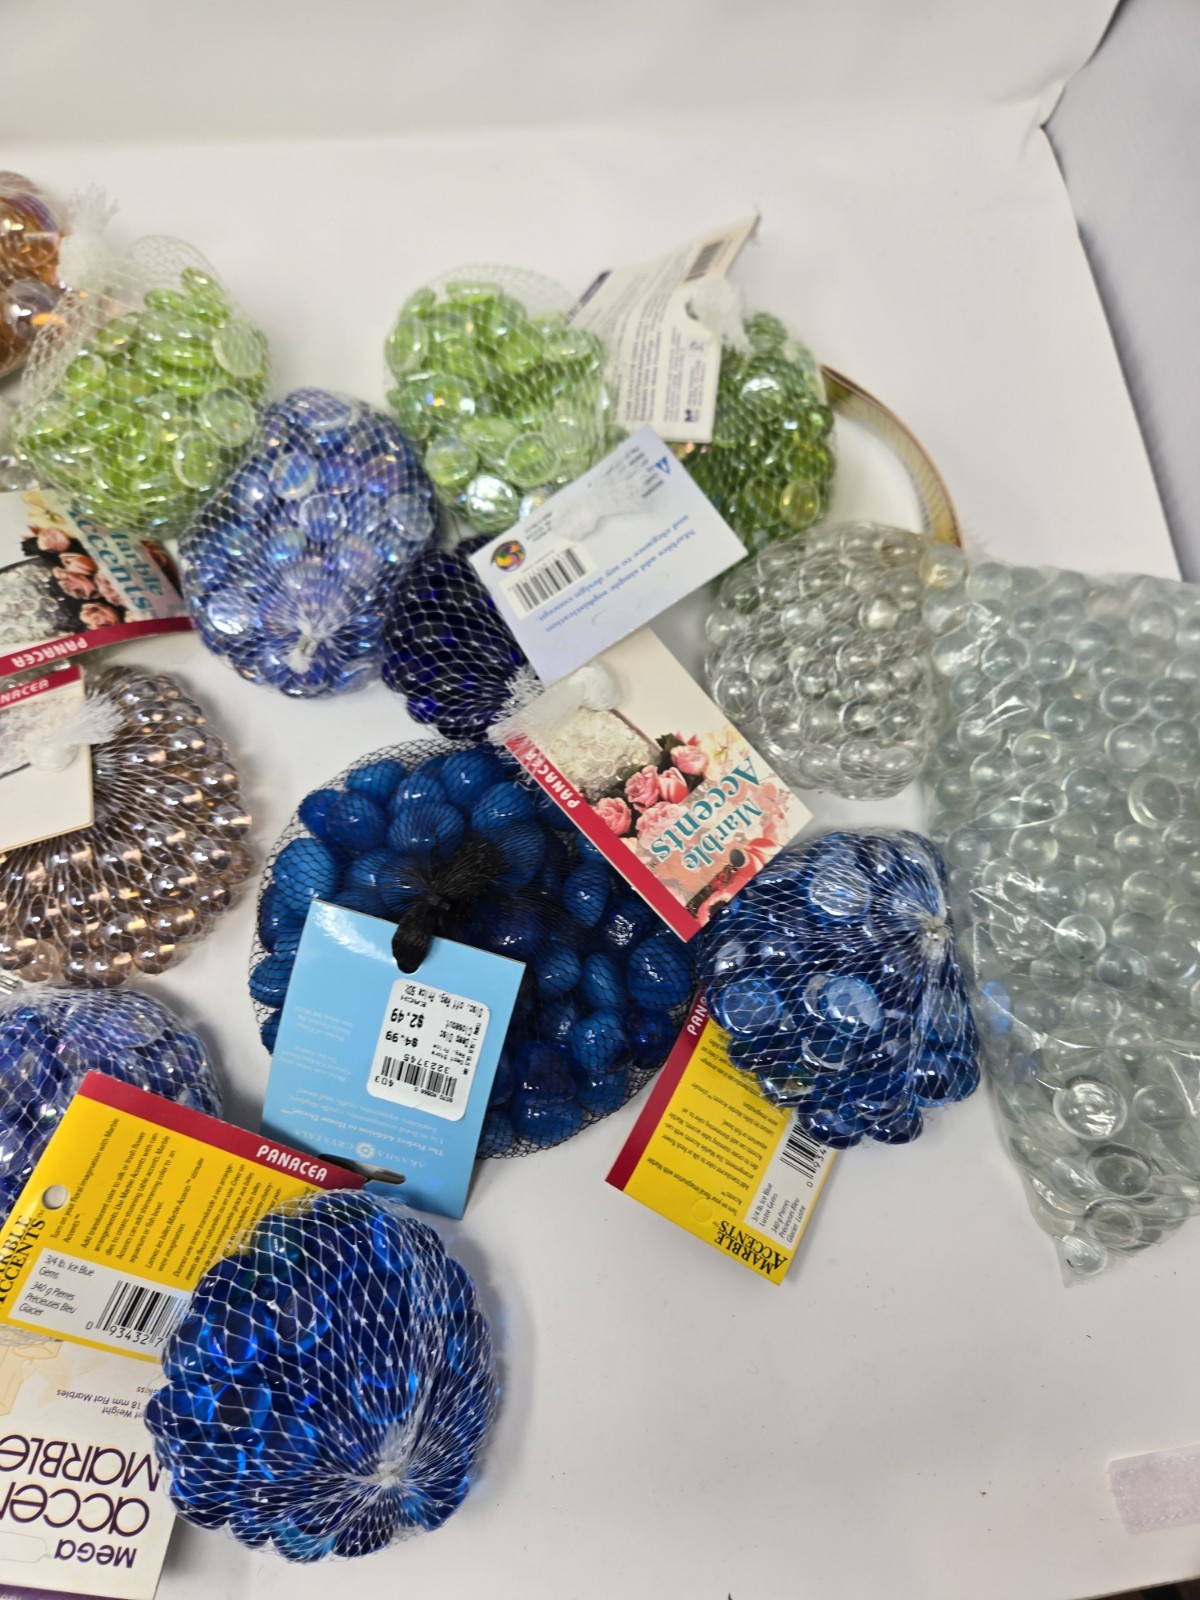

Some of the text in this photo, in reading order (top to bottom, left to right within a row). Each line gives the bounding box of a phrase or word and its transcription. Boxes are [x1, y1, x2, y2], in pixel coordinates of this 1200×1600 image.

[672, 515, 688, 530] and
[634, 528, 671, 558] elegance
[606, 565, 620, 577] any
[621, 557, 632, 566] to
[546, 530, 695, 632] Marbles add simple sophistication
[574, 577, 604, 598] design
[12, 638, 86, 666] PANACEA
[524, 749, 579, 808] PANACEA
[686, 803, 763, 868] Marble
[400, 995, 427, 1008] EACH
[390, 1008, 424, 1028] $2.49
[385, 1031, 418, 1048] $4.99
[403, 1054, 449, 1074] 3223745
[374, 1075, 394, 1087] 403
[257, 1146, 327, 1181] PANACEA
[50, 1119, 119, 1239] Turn on your floral imagination with Marble
[762, 1183, 773, 1196] Blue
[756, 1193, 778, 1227] Lustre Gems
[759, 1195, 767, 1205] Ice
[790, 1198, 800, 1211] Bleu
[771, 1221, 780, 1234] 340
[778, 1199, 793, 1218] Pierres
[782, 1205, 806, 1243] Glacier Lustre
[715, 1232, 774, 1274] MARBLE
[39, 1266, 59, 1279] Gems
[44, 1255, 58, 1265] 3/4
[67, 1262, 79, 1272] Ice
[78, 1265, 94, 1277] Blue
[30, 1281, 47, 1292] 340
[52, 1288, 75, 1301] Pierres
[19, 1303, 44, 1316] Glacier
[60, 1302, 76, 1314] Bleu
[86, 1320, 164, 1348] 0 93432 7
[57, 1389, 141, 1409] 18 mm Flat Marbles
[101, 1406, 132, 1417] Weight
